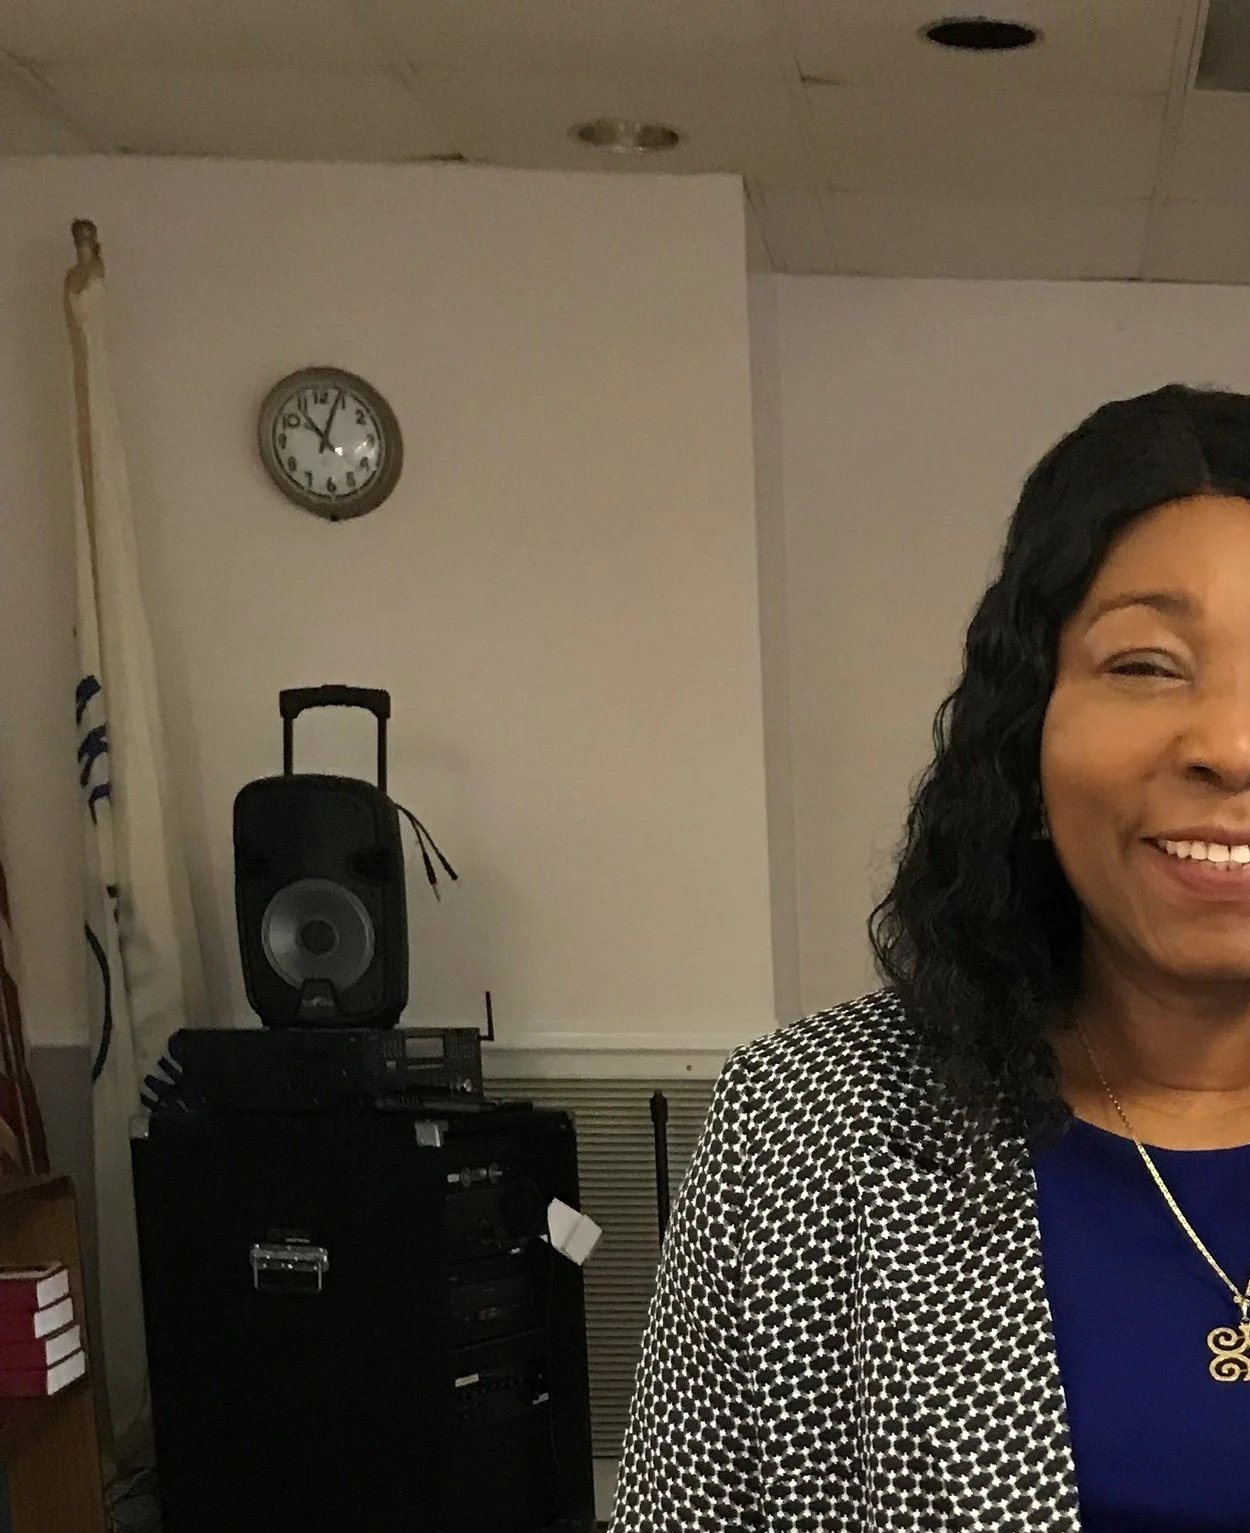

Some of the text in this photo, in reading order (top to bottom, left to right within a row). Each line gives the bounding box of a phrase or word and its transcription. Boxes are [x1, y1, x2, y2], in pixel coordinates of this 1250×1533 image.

[314, 391, 329, 405] 12
[282, 412, 300, 429] 10
[355, 409, 366, 426] 2
[327, 476, 337, 493] 6
